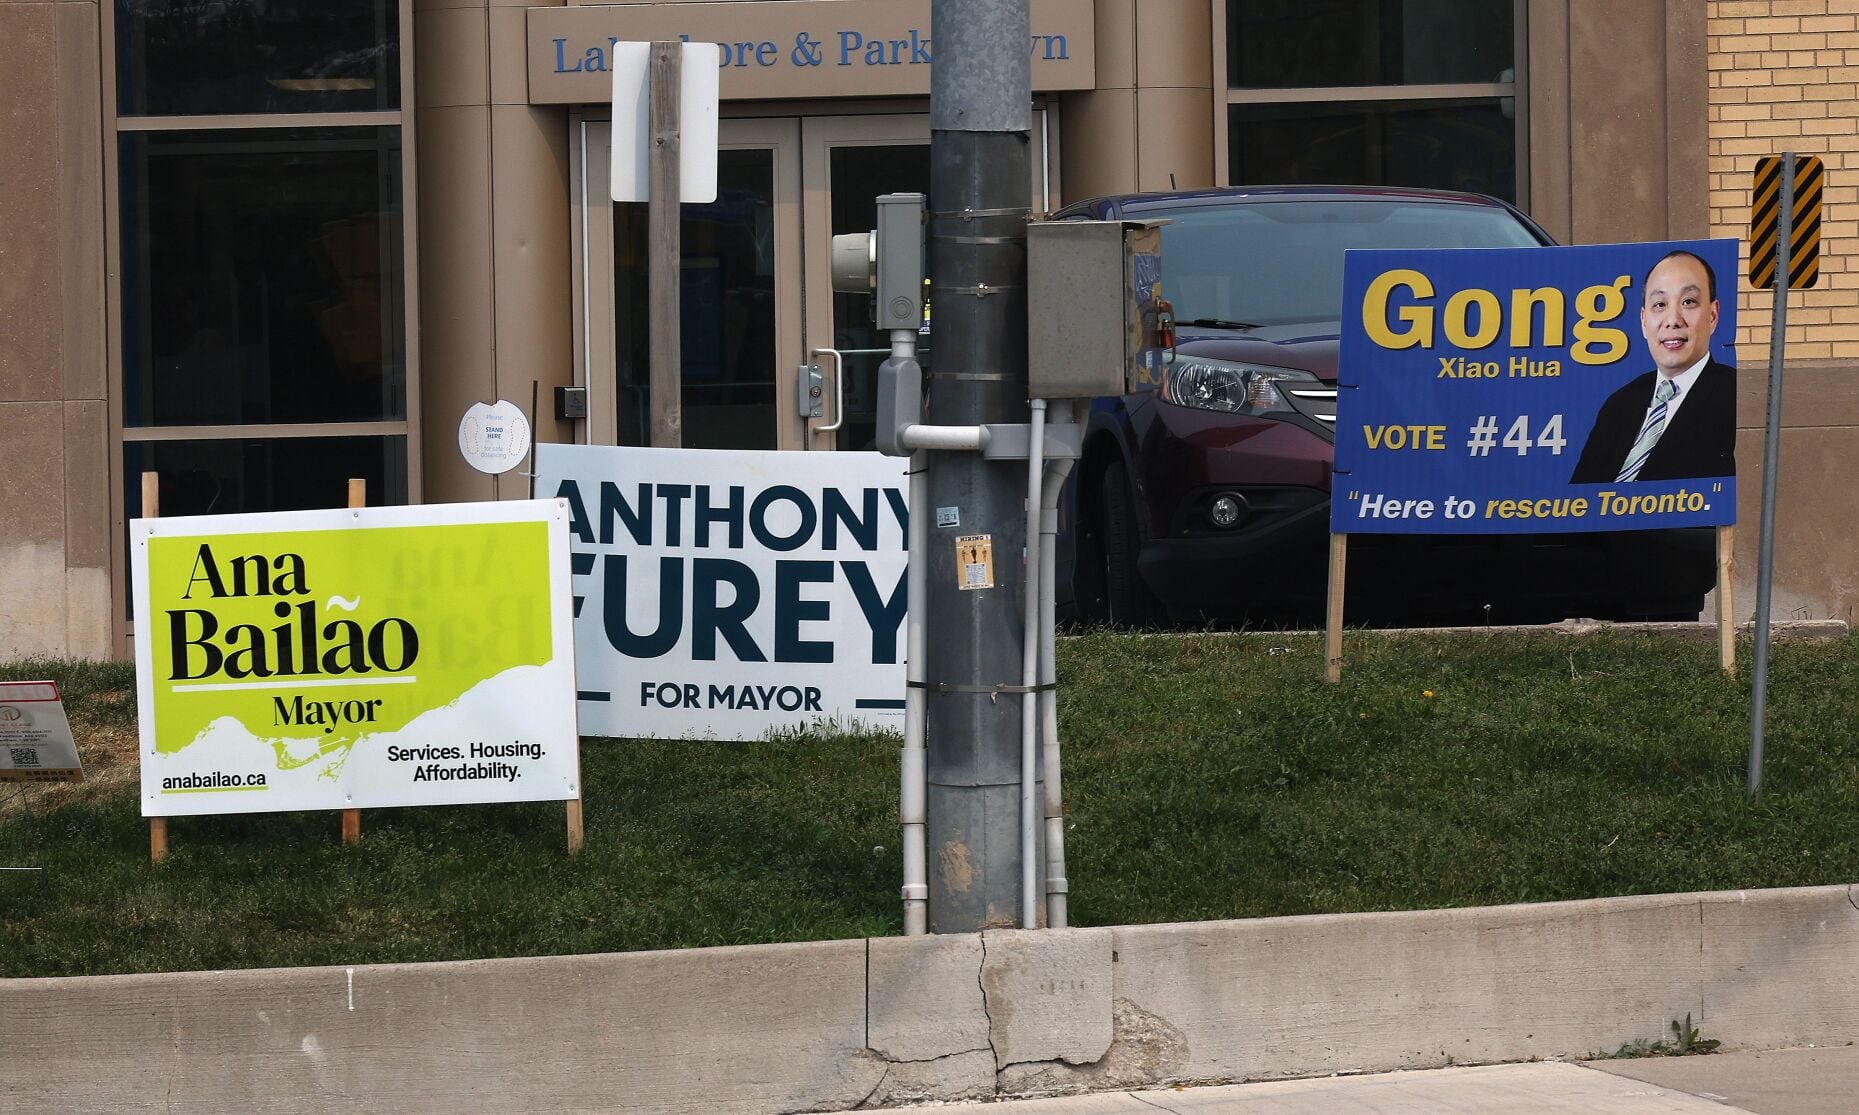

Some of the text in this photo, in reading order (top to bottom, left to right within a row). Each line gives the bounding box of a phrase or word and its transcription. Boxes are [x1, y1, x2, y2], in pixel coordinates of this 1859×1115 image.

[791, 32, 823, 67] &
[1362, 268, 1632, 365] Gong
[1437, 356, 1561, 379] Xiao Hua
[1363, 414, 1567, 457] VOTE #44
[1444, 495, 1476, 519] to
[1485, 495, 1588, 520] rescue
[182, 543, 311, 600] Ana
[165, 595, 419, 681] Bailão
[640, 681, 823, 712] FOR MAYOR
[272, 695, 383, 734] Mayor
[387, 740, 546, 764] Services. Housing.
[162, 771, 266, 790] anabailao.ca
[412, 762, 521, 784] Affordability.
